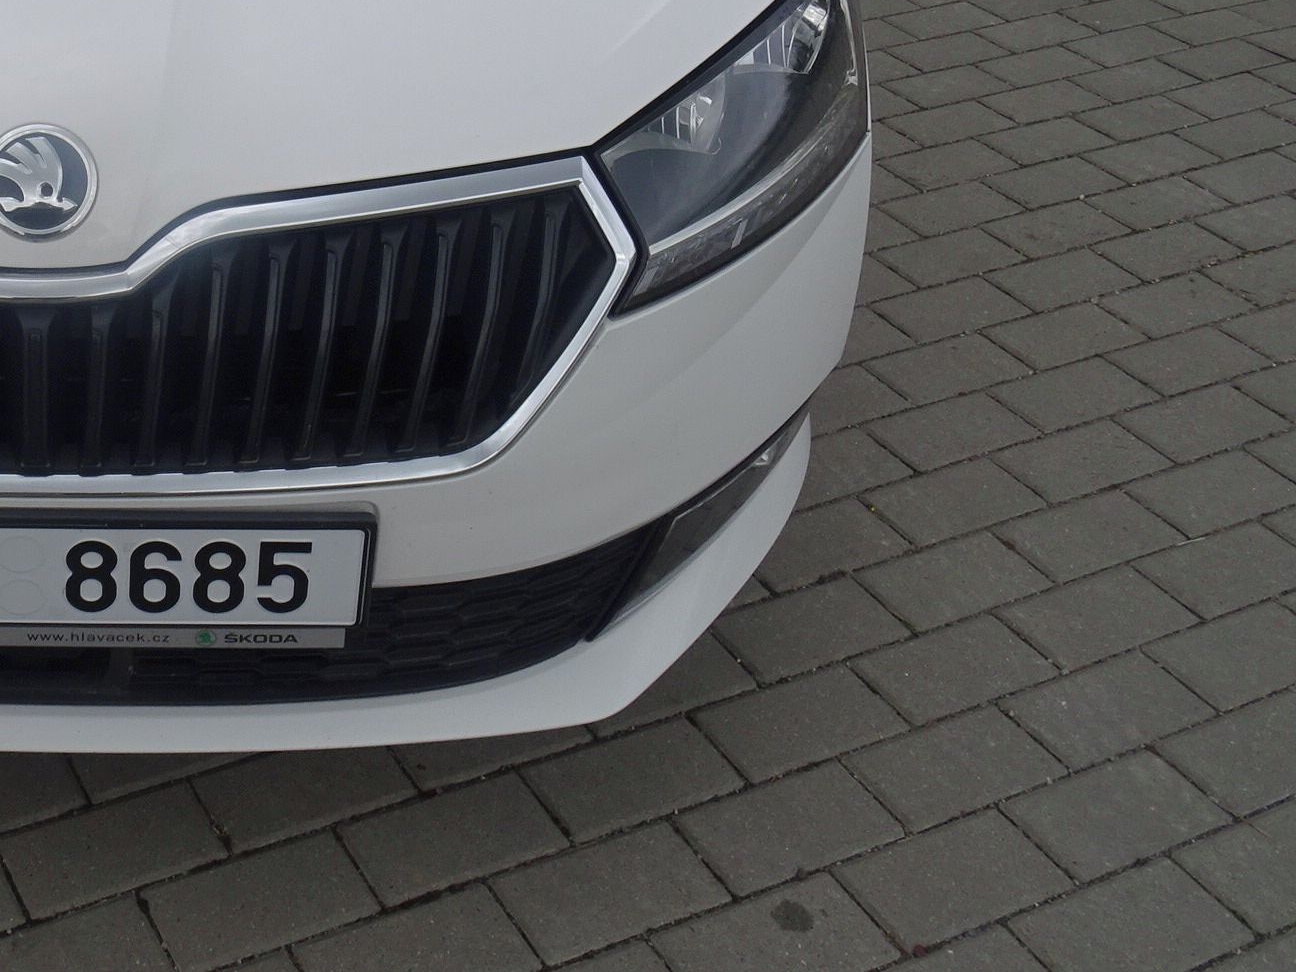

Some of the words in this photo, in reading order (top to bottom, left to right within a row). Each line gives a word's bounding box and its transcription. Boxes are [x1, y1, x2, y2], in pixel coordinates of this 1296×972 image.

[65, 540, 313, 614] 8685
[27, 631, 170, 644] www.hlavacek.cz
[224, 632, 299, 644] ŠKODA
